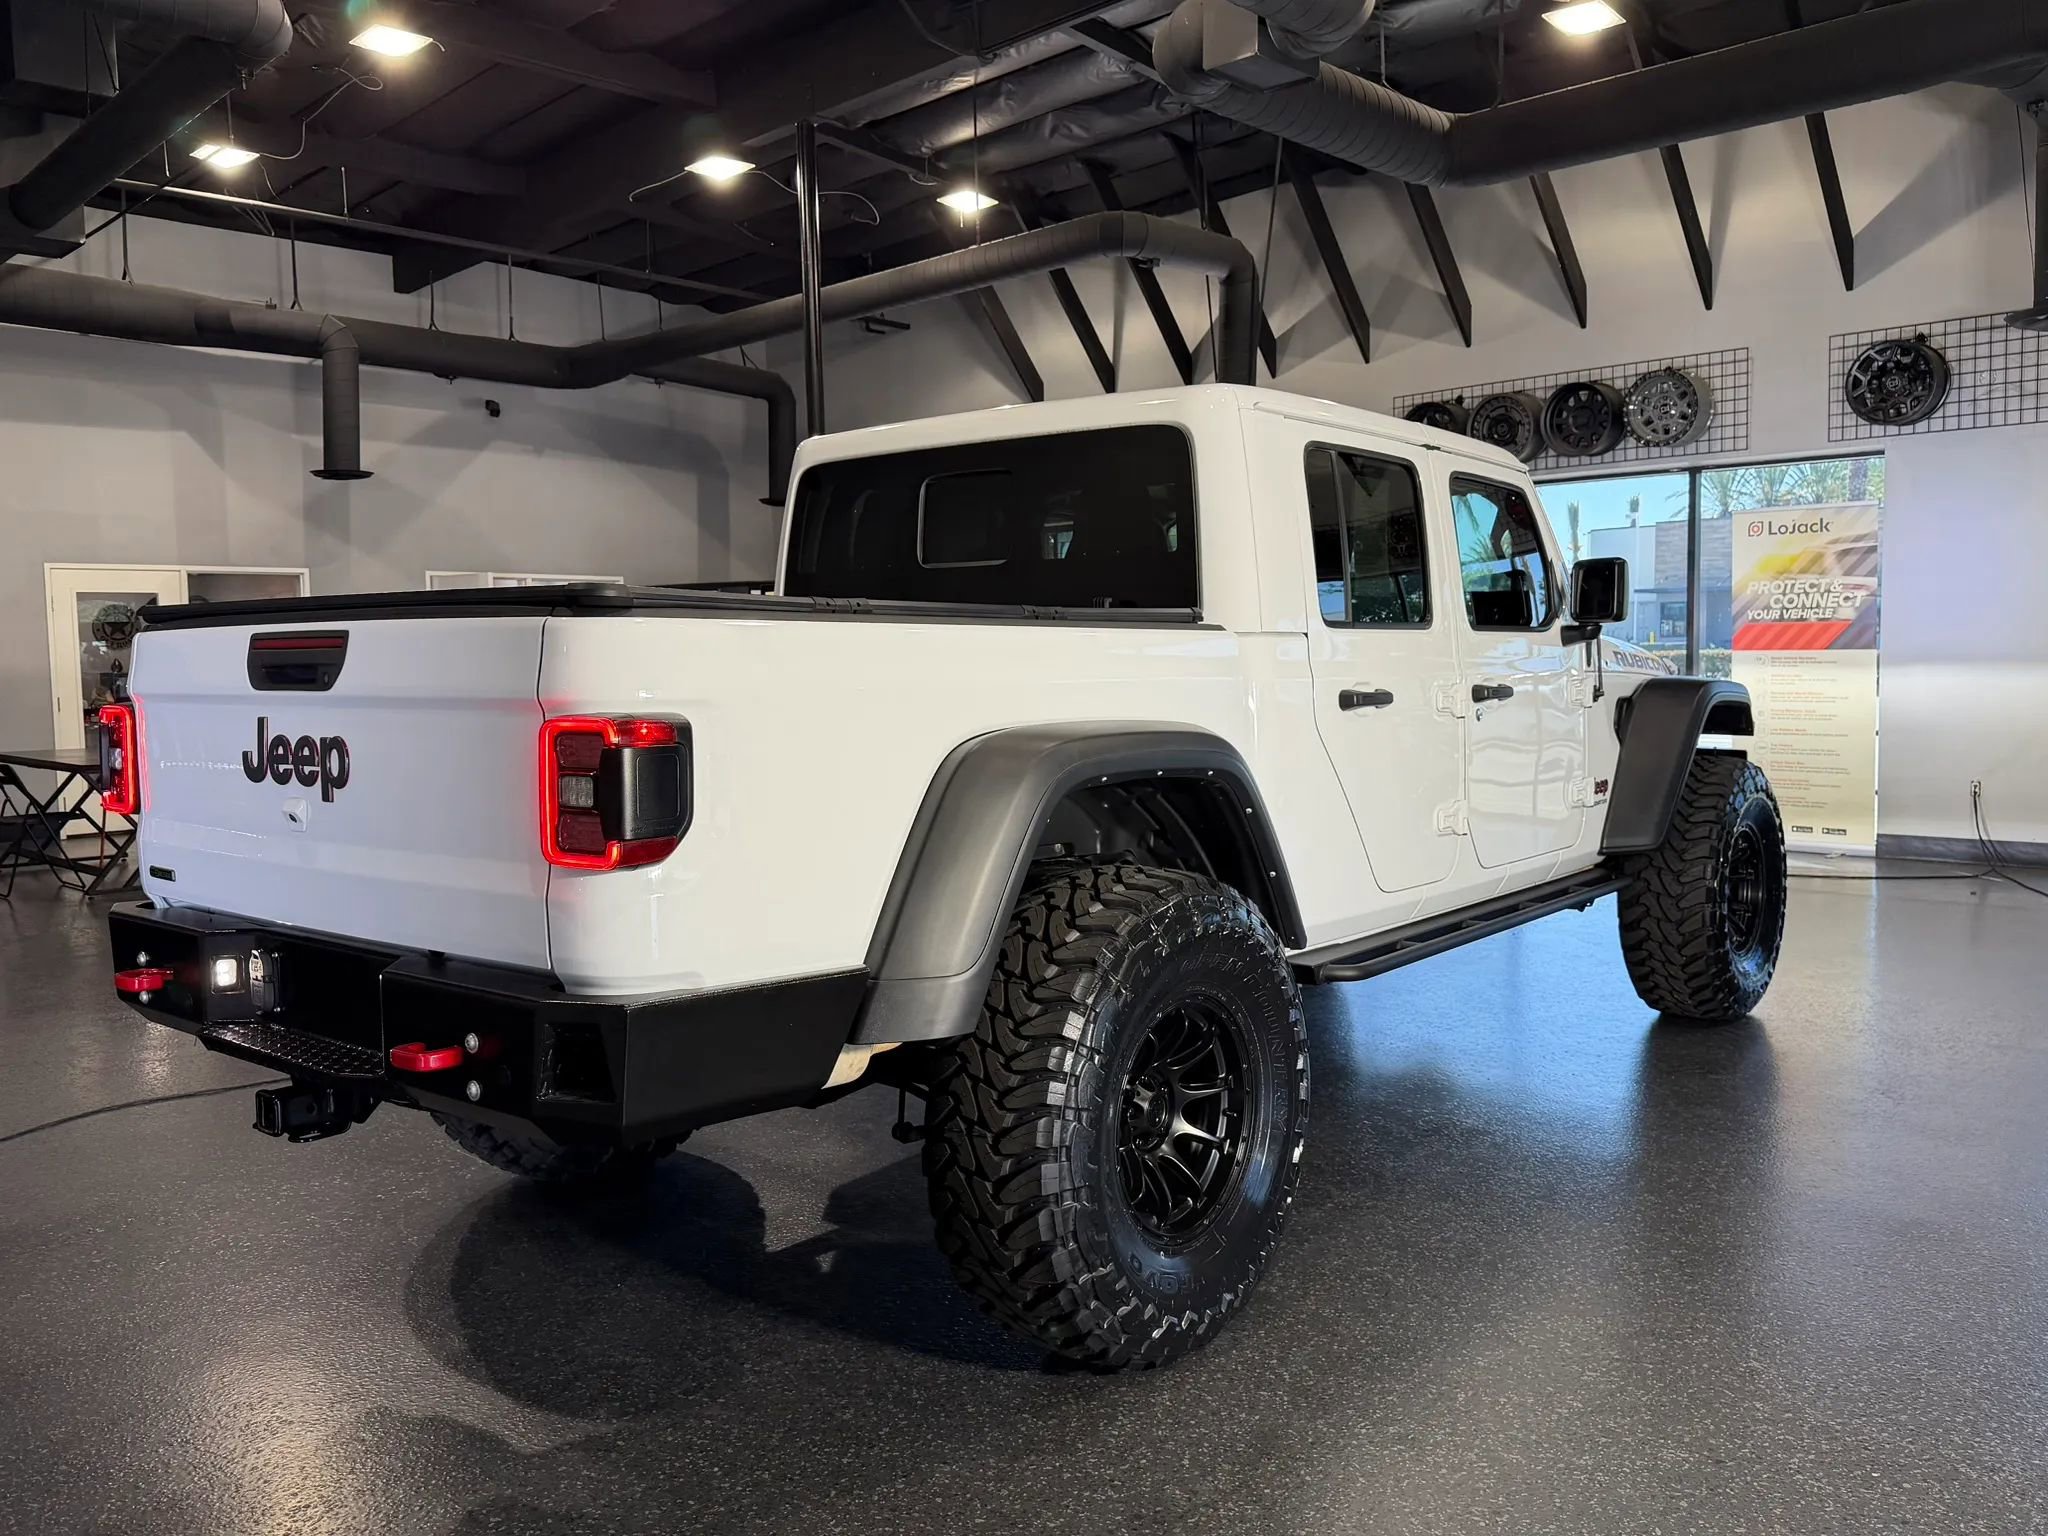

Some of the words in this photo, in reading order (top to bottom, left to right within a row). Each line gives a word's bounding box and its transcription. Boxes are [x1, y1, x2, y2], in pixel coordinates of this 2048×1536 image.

[1746, 579, 1829, 595] PROTECT
[1830, 578, 1843, 592] &
[1769, 591, 1866, 609] CONNECT
[1747, 609, 1781, 620] YOUR
[1782, 608, 1834, 619] VEHICLE
[242, 716, 350, 803] Jeep
